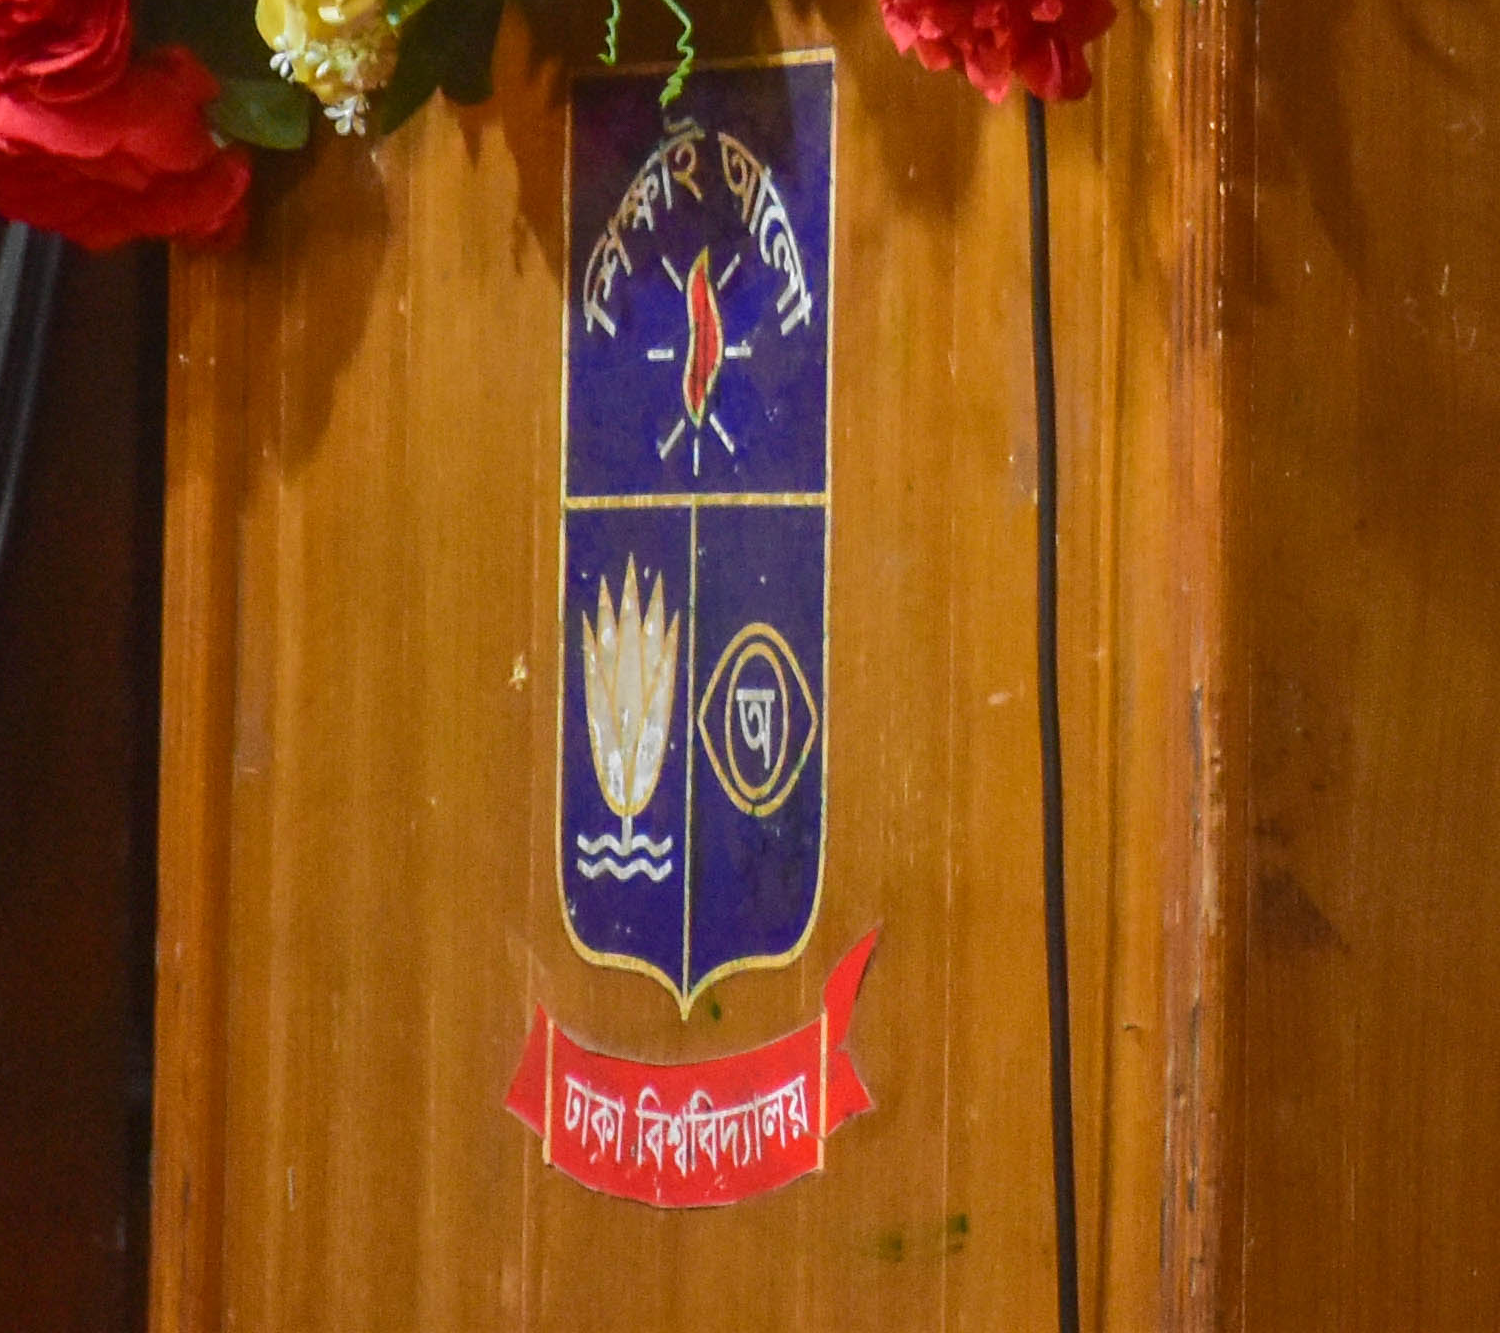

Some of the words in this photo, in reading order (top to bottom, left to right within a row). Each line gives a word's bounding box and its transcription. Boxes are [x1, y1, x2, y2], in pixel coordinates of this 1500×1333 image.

[716, 131, 813, 336] আলো
[735, 688, 776, 770] অ
[563, 1075, 626, 1163] ঢাকা
[635, 1074, 809, 1178] বিশ্ববিদ্যালয়
